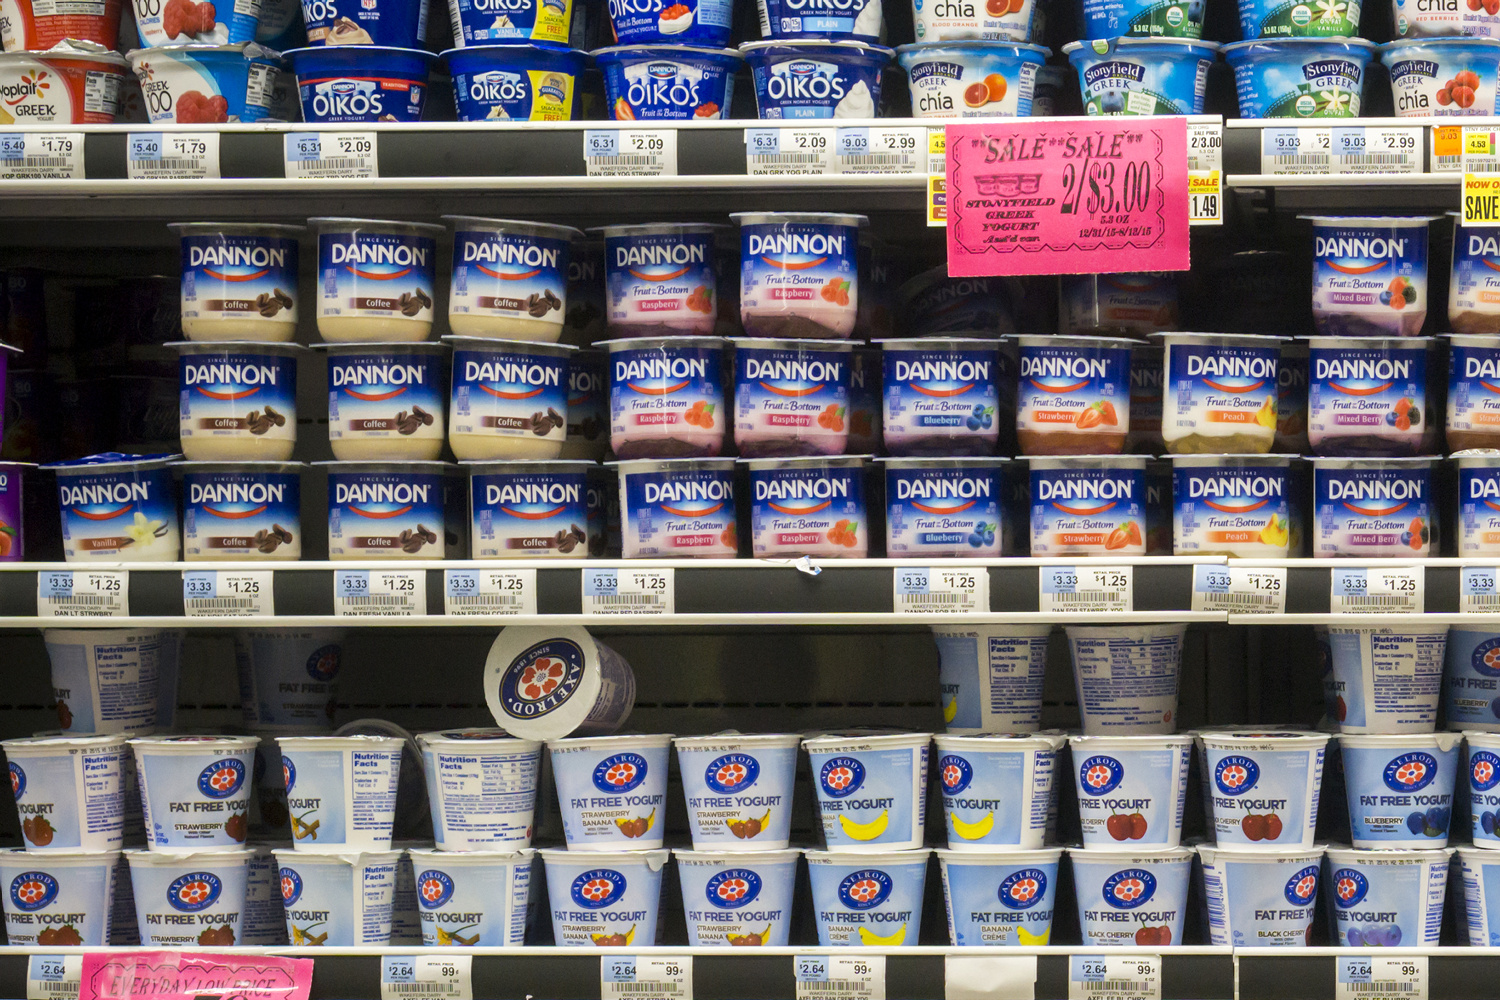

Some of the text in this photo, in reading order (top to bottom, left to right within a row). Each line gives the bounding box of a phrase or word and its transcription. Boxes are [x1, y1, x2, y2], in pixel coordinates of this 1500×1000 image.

[912, 63, 959, 80] Stonyfield
[768, 76, 844, 99] OIKOS
[313, 93, 383, 116] OIKOS
[16, 104, 56, 117] GREEK
[795, 109, 815, 117] PLAIN
[174, 142, 206, 153] $1.79
[884, 138, 915, 148] $2.99
[1060, 159, 1150, 220] 2/$3.00
[966, 198, 1055, 208] STONYFIELD
[1193, 196, 1216, 217] 1.49
[1466, 196, 1498, 219] SAVE
[986, 211, 1034, 219] GREEK
[1116, 215, 1129, 223] OZ
[983, 222, 1039, 231] YOGURT
[749, 234, 843, 255] DANNON
[190, 247, 284, 267] DANNON
[775, 289, 813, 299] Raspberry
[224, 301, 249, 310] Coffee
[1188, 354, 1277, 377] DANNON
[924, 416, 961, 425] Blueberry
[1038, 412, 1076, 422] Strawberry
[1223, 412, 1245, 421] Peach
[61, 482, 148, 505] DANNON
[92, 539, 117, 547] Vanilla
[1353, 535, 1398, 545] Mixed Berry
[90, 578, 120, 591] $1.25
[1249, 578, 1281, 590] $1.25
[571, 795, 663, 807] FAT FREE YOGURT
